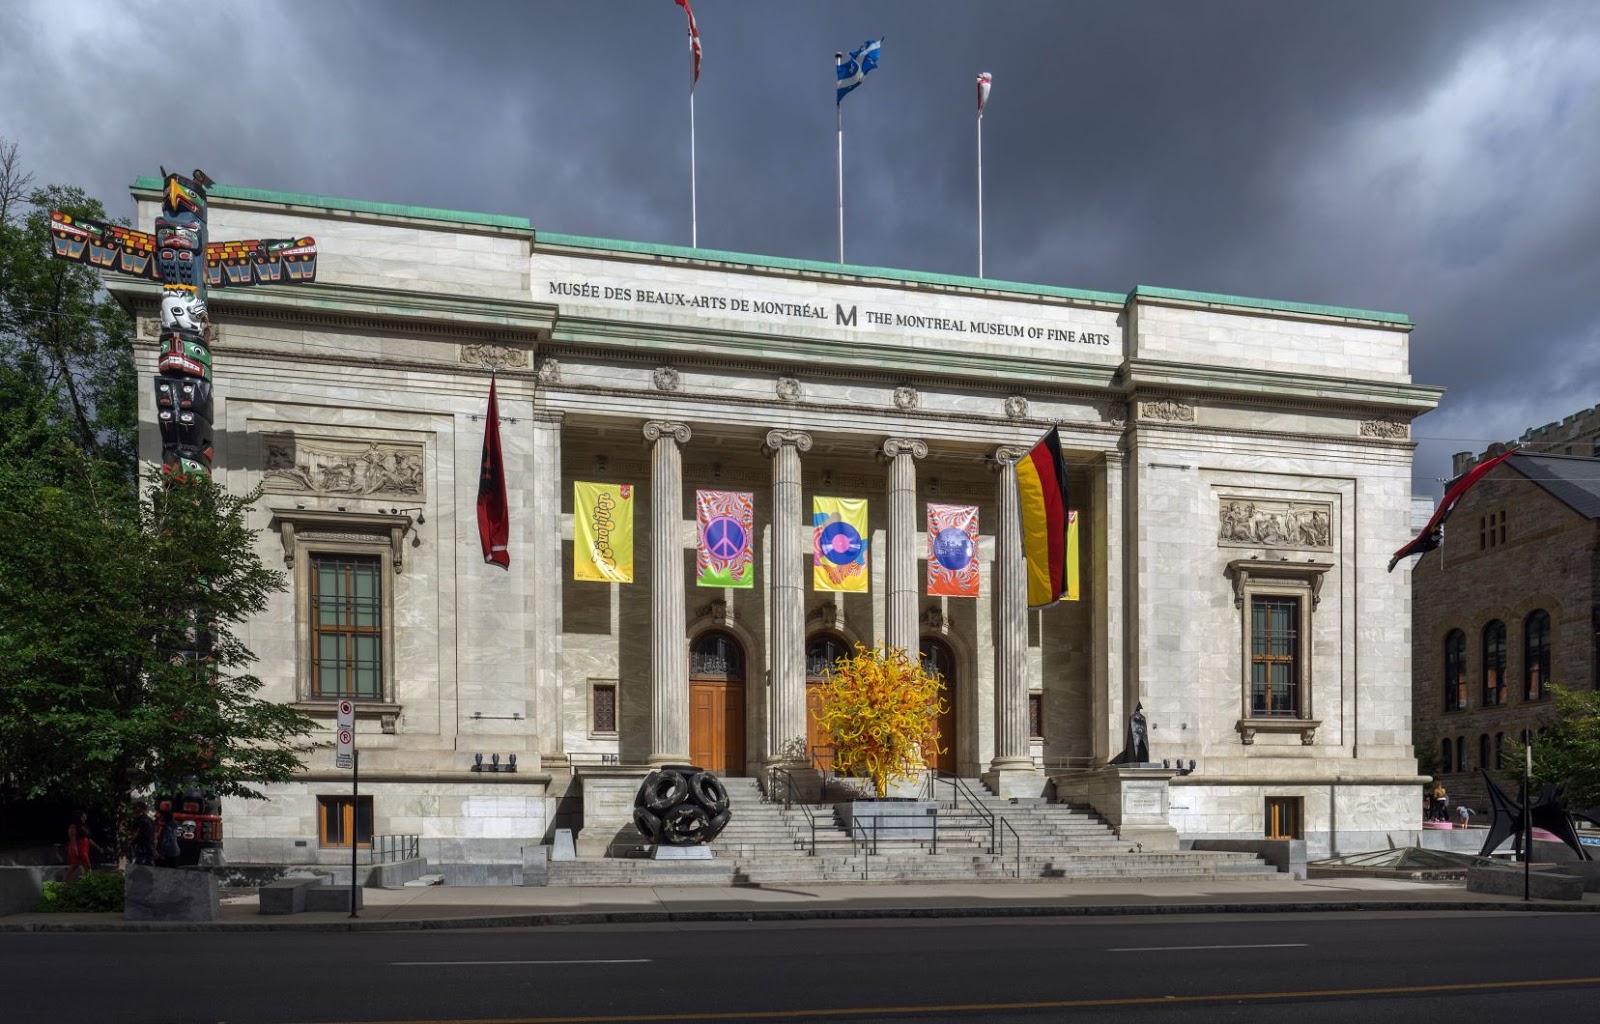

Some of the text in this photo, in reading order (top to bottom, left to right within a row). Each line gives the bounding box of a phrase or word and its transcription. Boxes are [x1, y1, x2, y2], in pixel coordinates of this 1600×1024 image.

[549, 281, 829, 320] MUSÉE DES BEAUX-ARTS DE MONTRÉAL
[835, 303, 858, 327] M
[866, 311, 1110, 346] THE MONTREAL MUSEUM OF FINE ARTS
